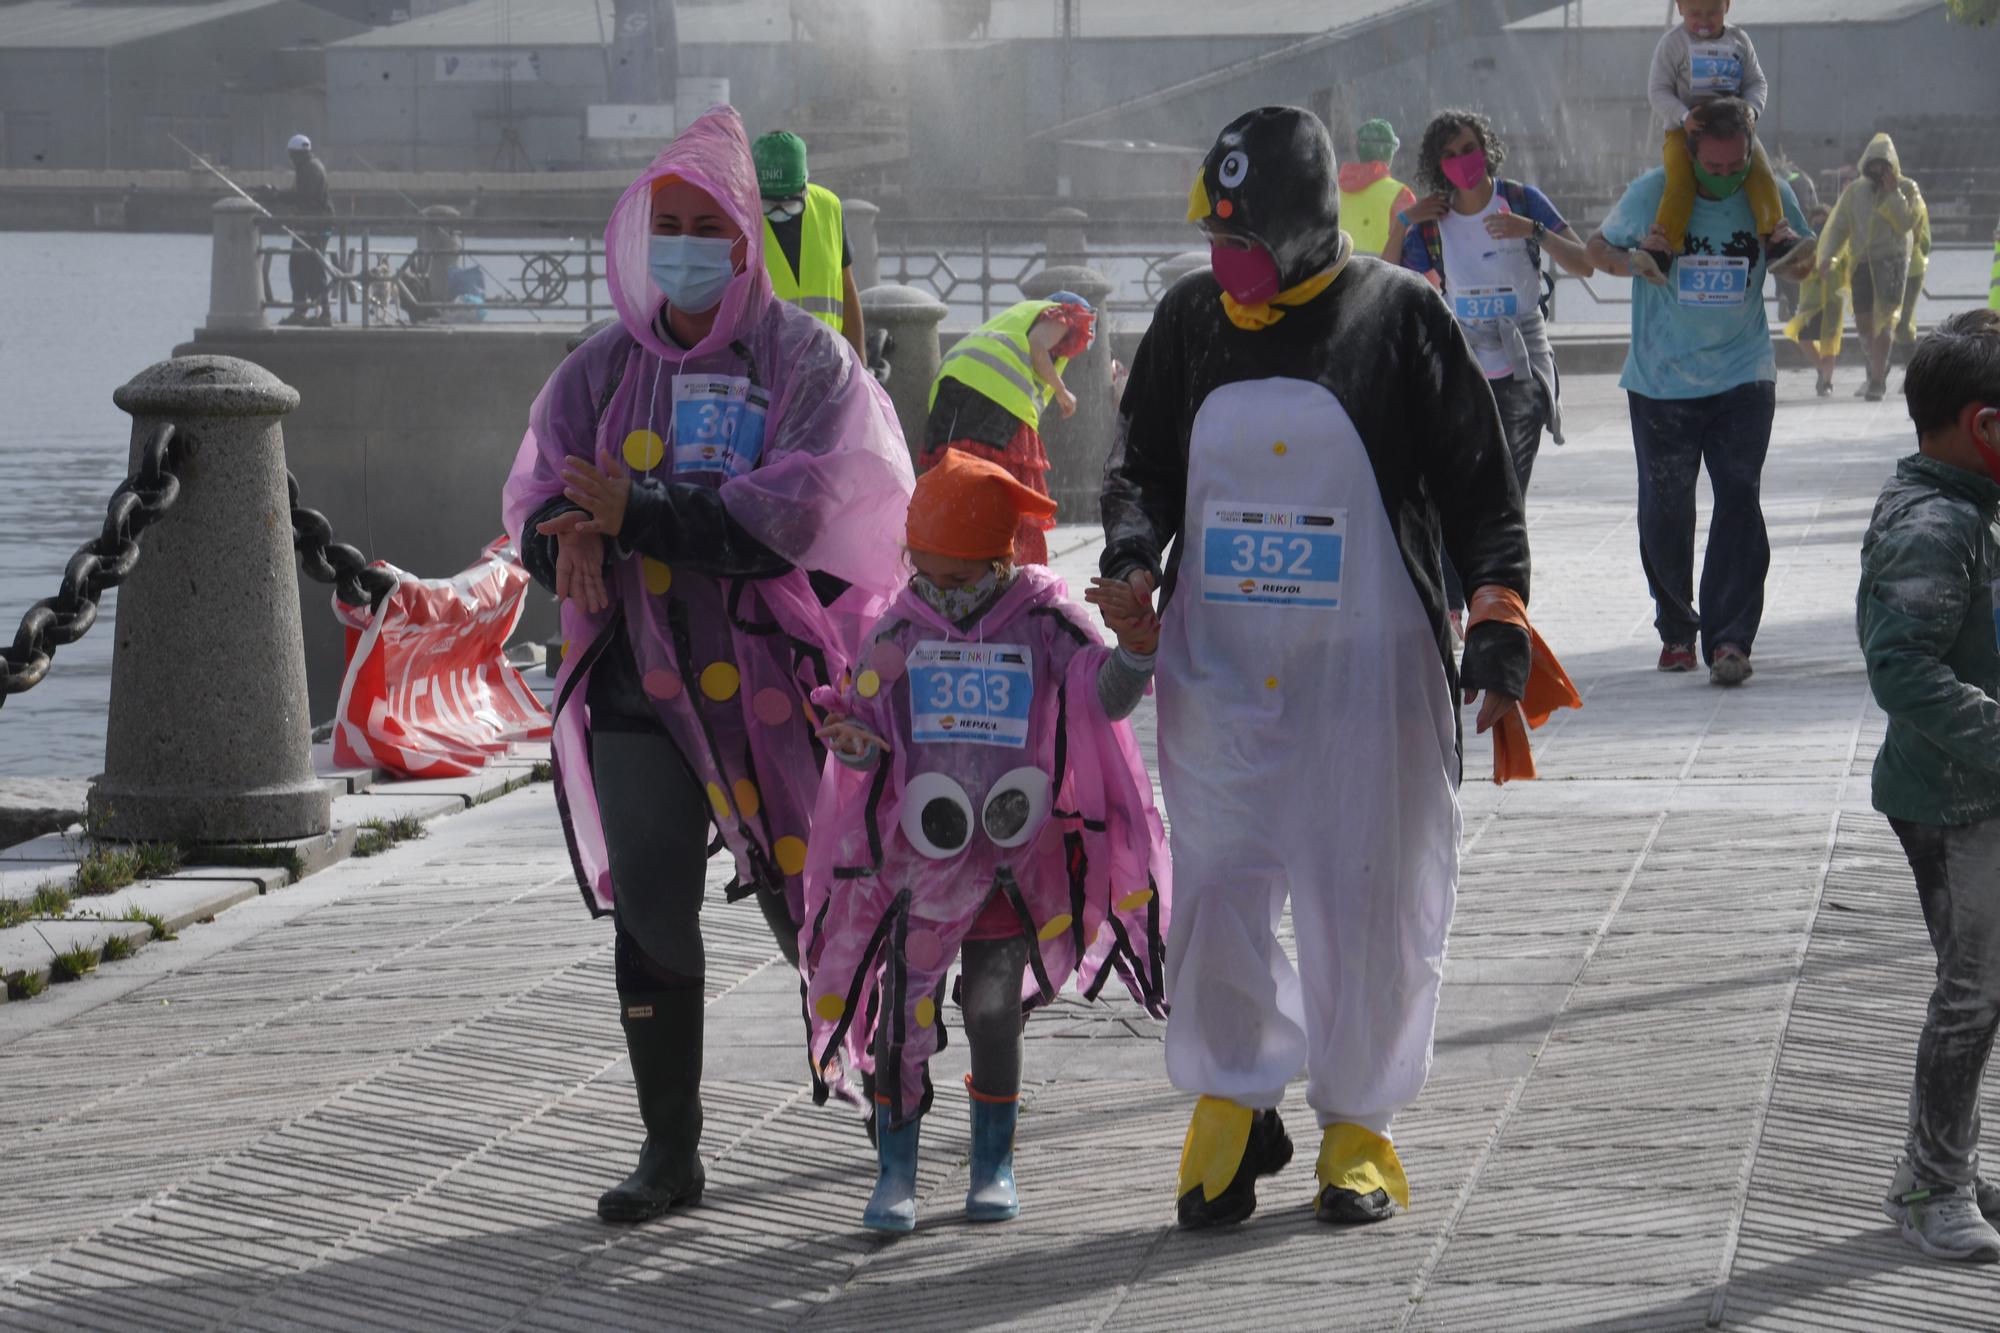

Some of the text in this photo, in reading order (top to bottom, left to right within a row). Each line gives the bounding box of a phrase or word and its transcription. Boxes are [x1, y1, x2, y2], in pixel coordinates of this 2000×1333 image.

[1692, 271, 1734, 290] 379
[1467, 298, 1505, 316] 378
[1264, 511, 1288, 525] ENKI
[1231, 534, 1313, 576] 352
[1262, 583, 1302, 594] REPSOL
[930, 671, 1010, 712] 363
[959, 719, 999, 731] REPSOL
